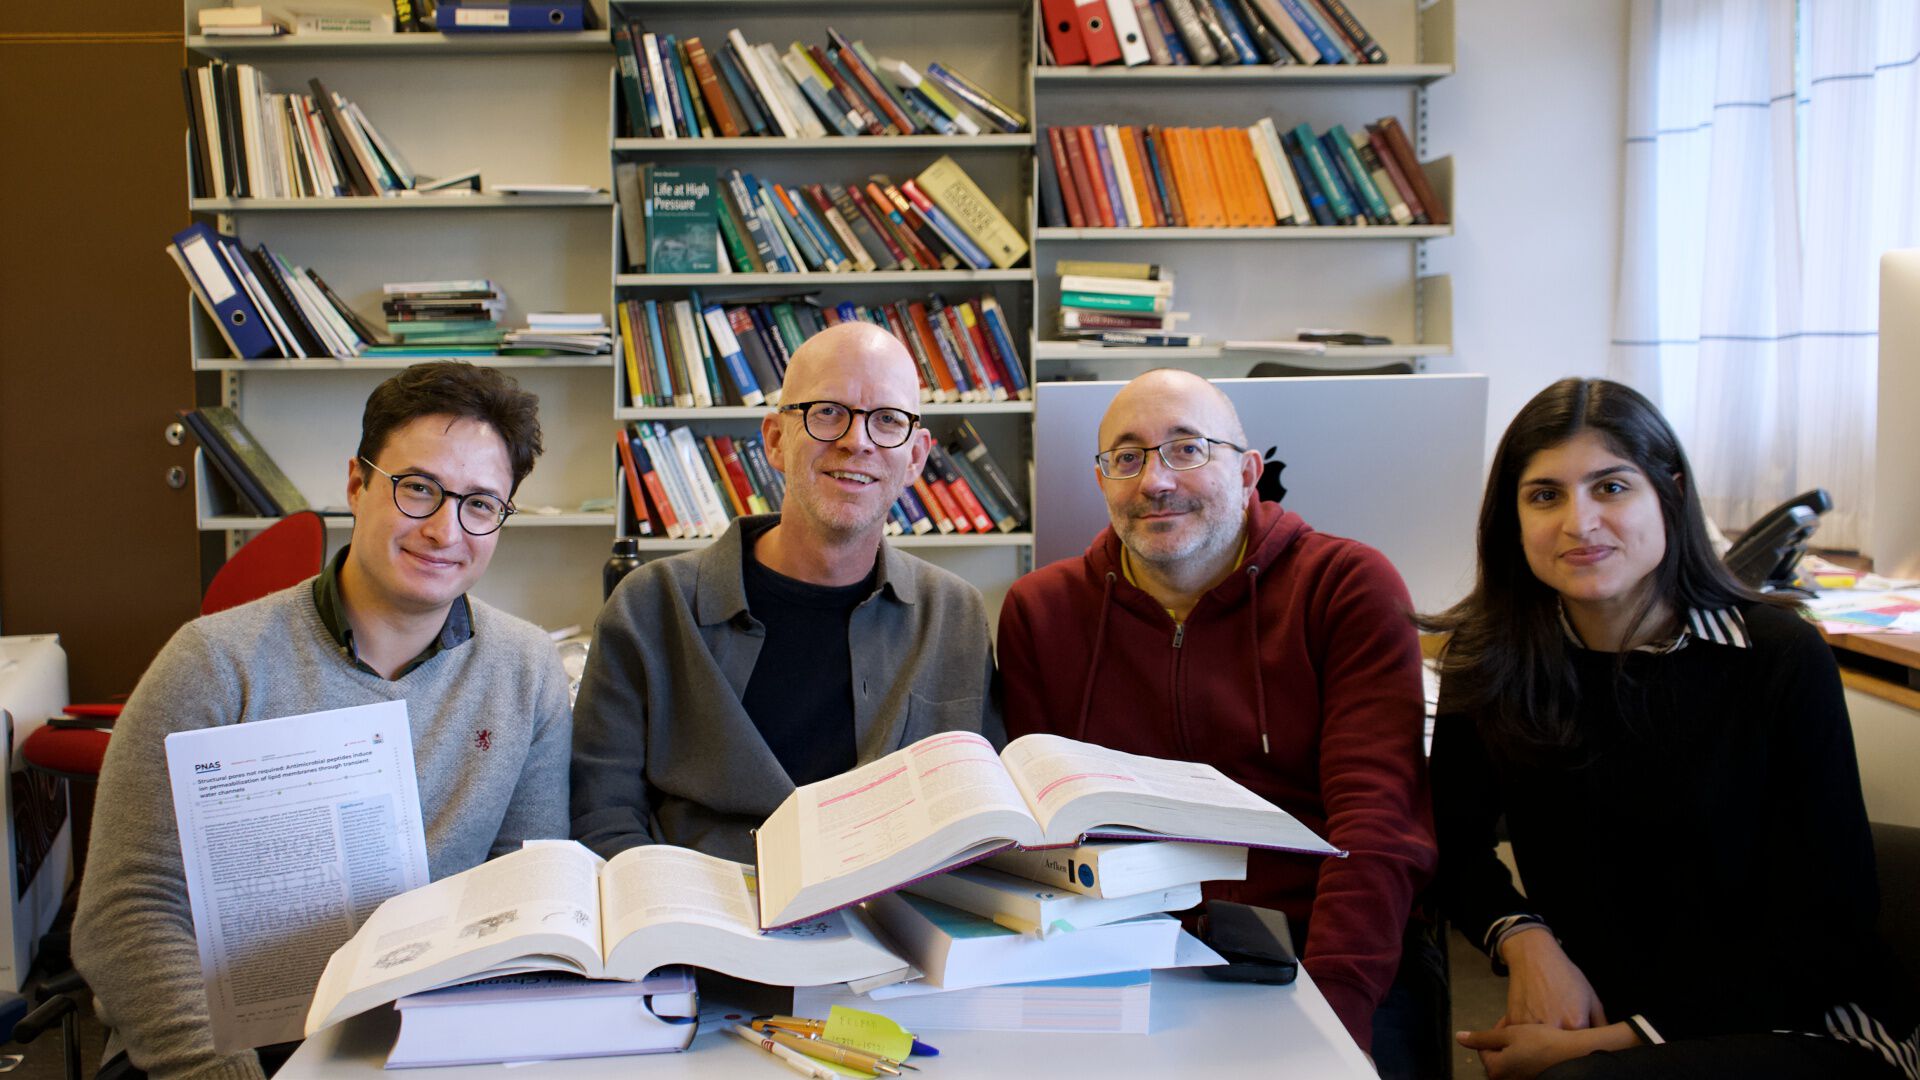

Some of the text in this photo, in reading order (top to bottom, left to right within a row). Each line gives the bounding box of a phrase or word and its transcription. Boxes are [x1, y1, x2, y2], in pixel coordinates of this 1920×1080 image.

[654, 182, 710, 200] Life at High
[654, 196, 696, 210] Pressure
[194, 761, 220, 771] PNAS
[197, 775, 226, 784] Structural
[285, 758, 325, 769] Antimicrobial
[209, 777, 259, 789] permeabilization
[282, 767, 317, 777] membranes
[318, 763, 342, 771] through
[217, 787, 244, 795] channels
[1044, 859, 1067, 873] Arfken
